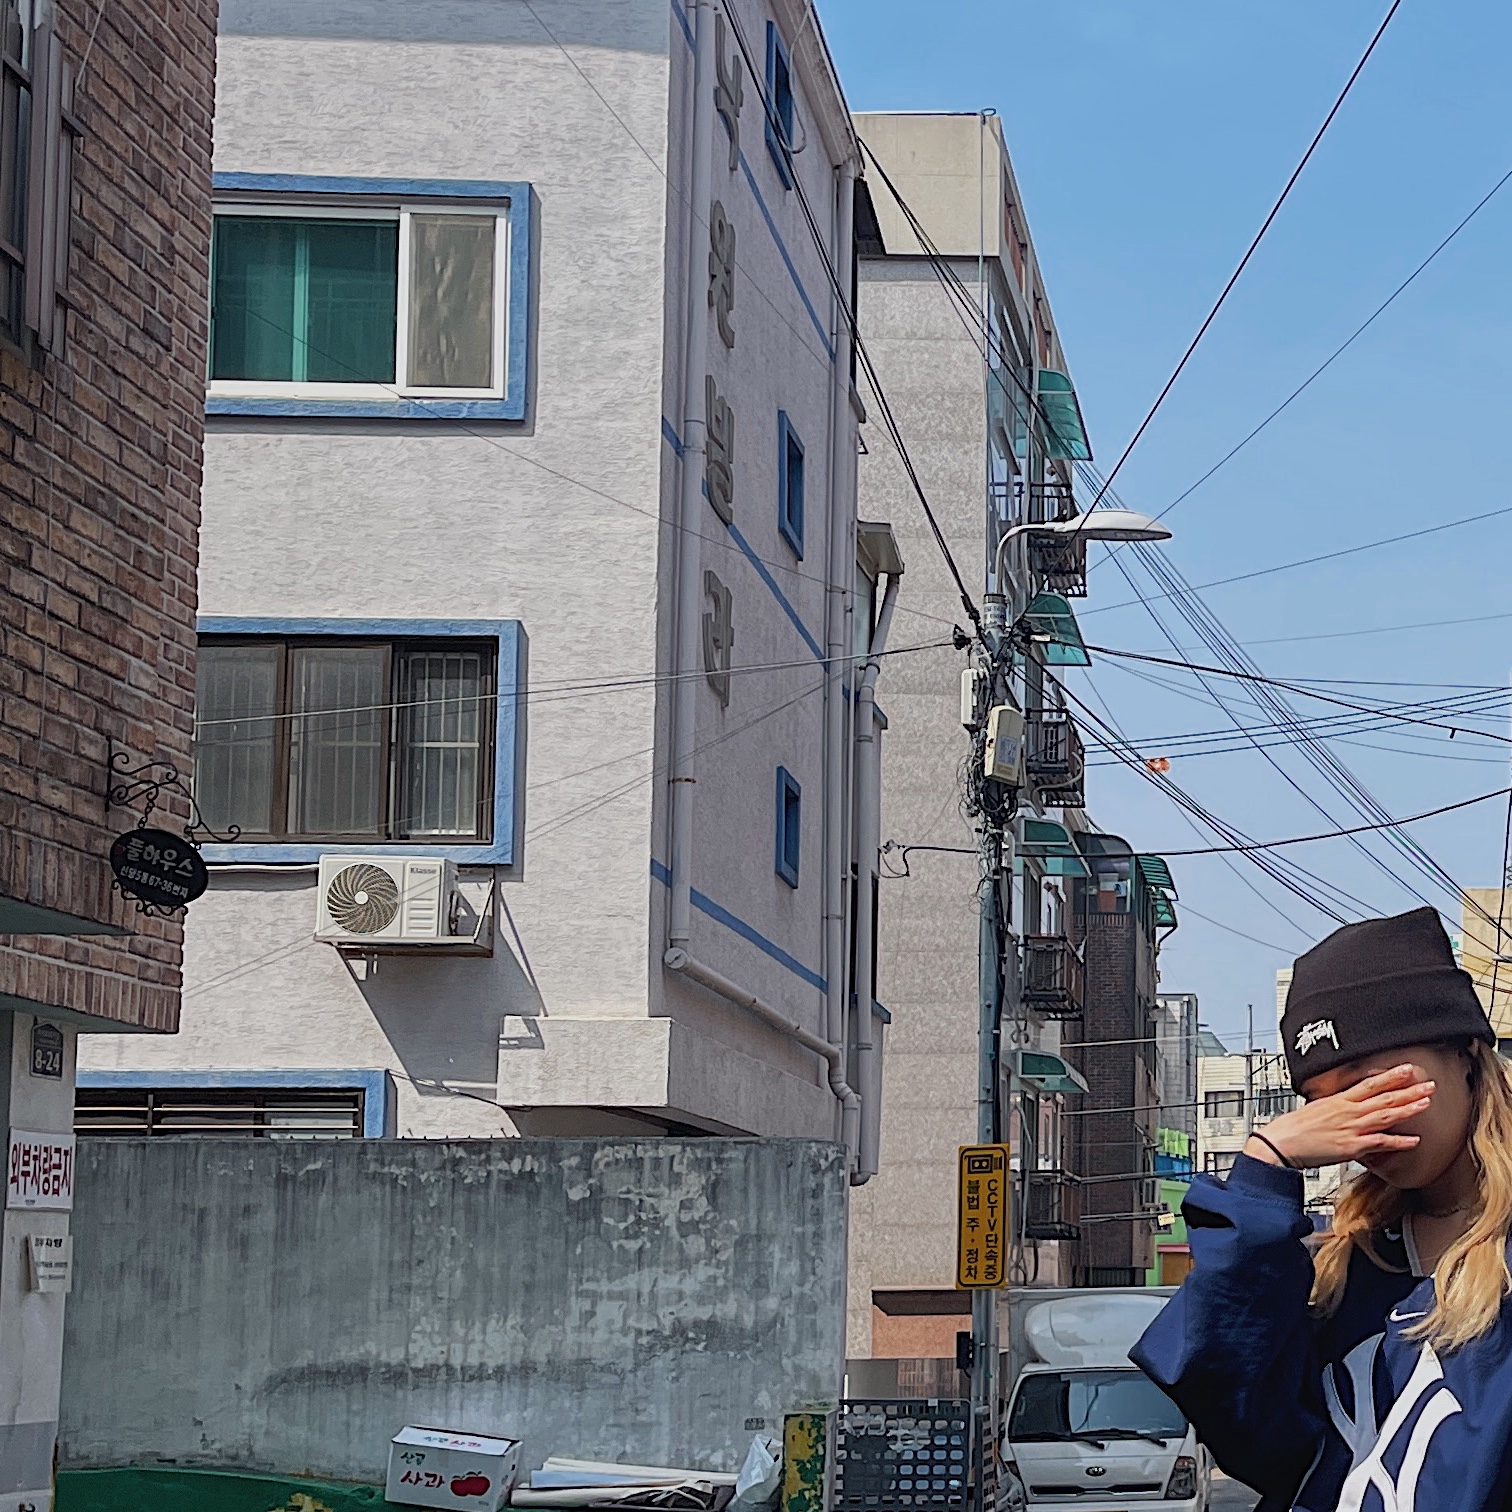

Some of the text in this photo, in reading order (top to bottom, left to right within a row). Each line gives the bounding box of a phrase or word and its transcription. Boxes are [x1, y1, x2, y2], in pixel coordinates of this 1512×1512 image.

[126, 837, 193, 878] 풀하우스
[410, 867, 437, 875] Klasse
[35, 1048, 60, 1072] 8-24
[10, 1141, 73, 1197] 외부차량금지
[966, 1179, 980, 1210] 불법
[400, 1470, 445, 1488] 사과
